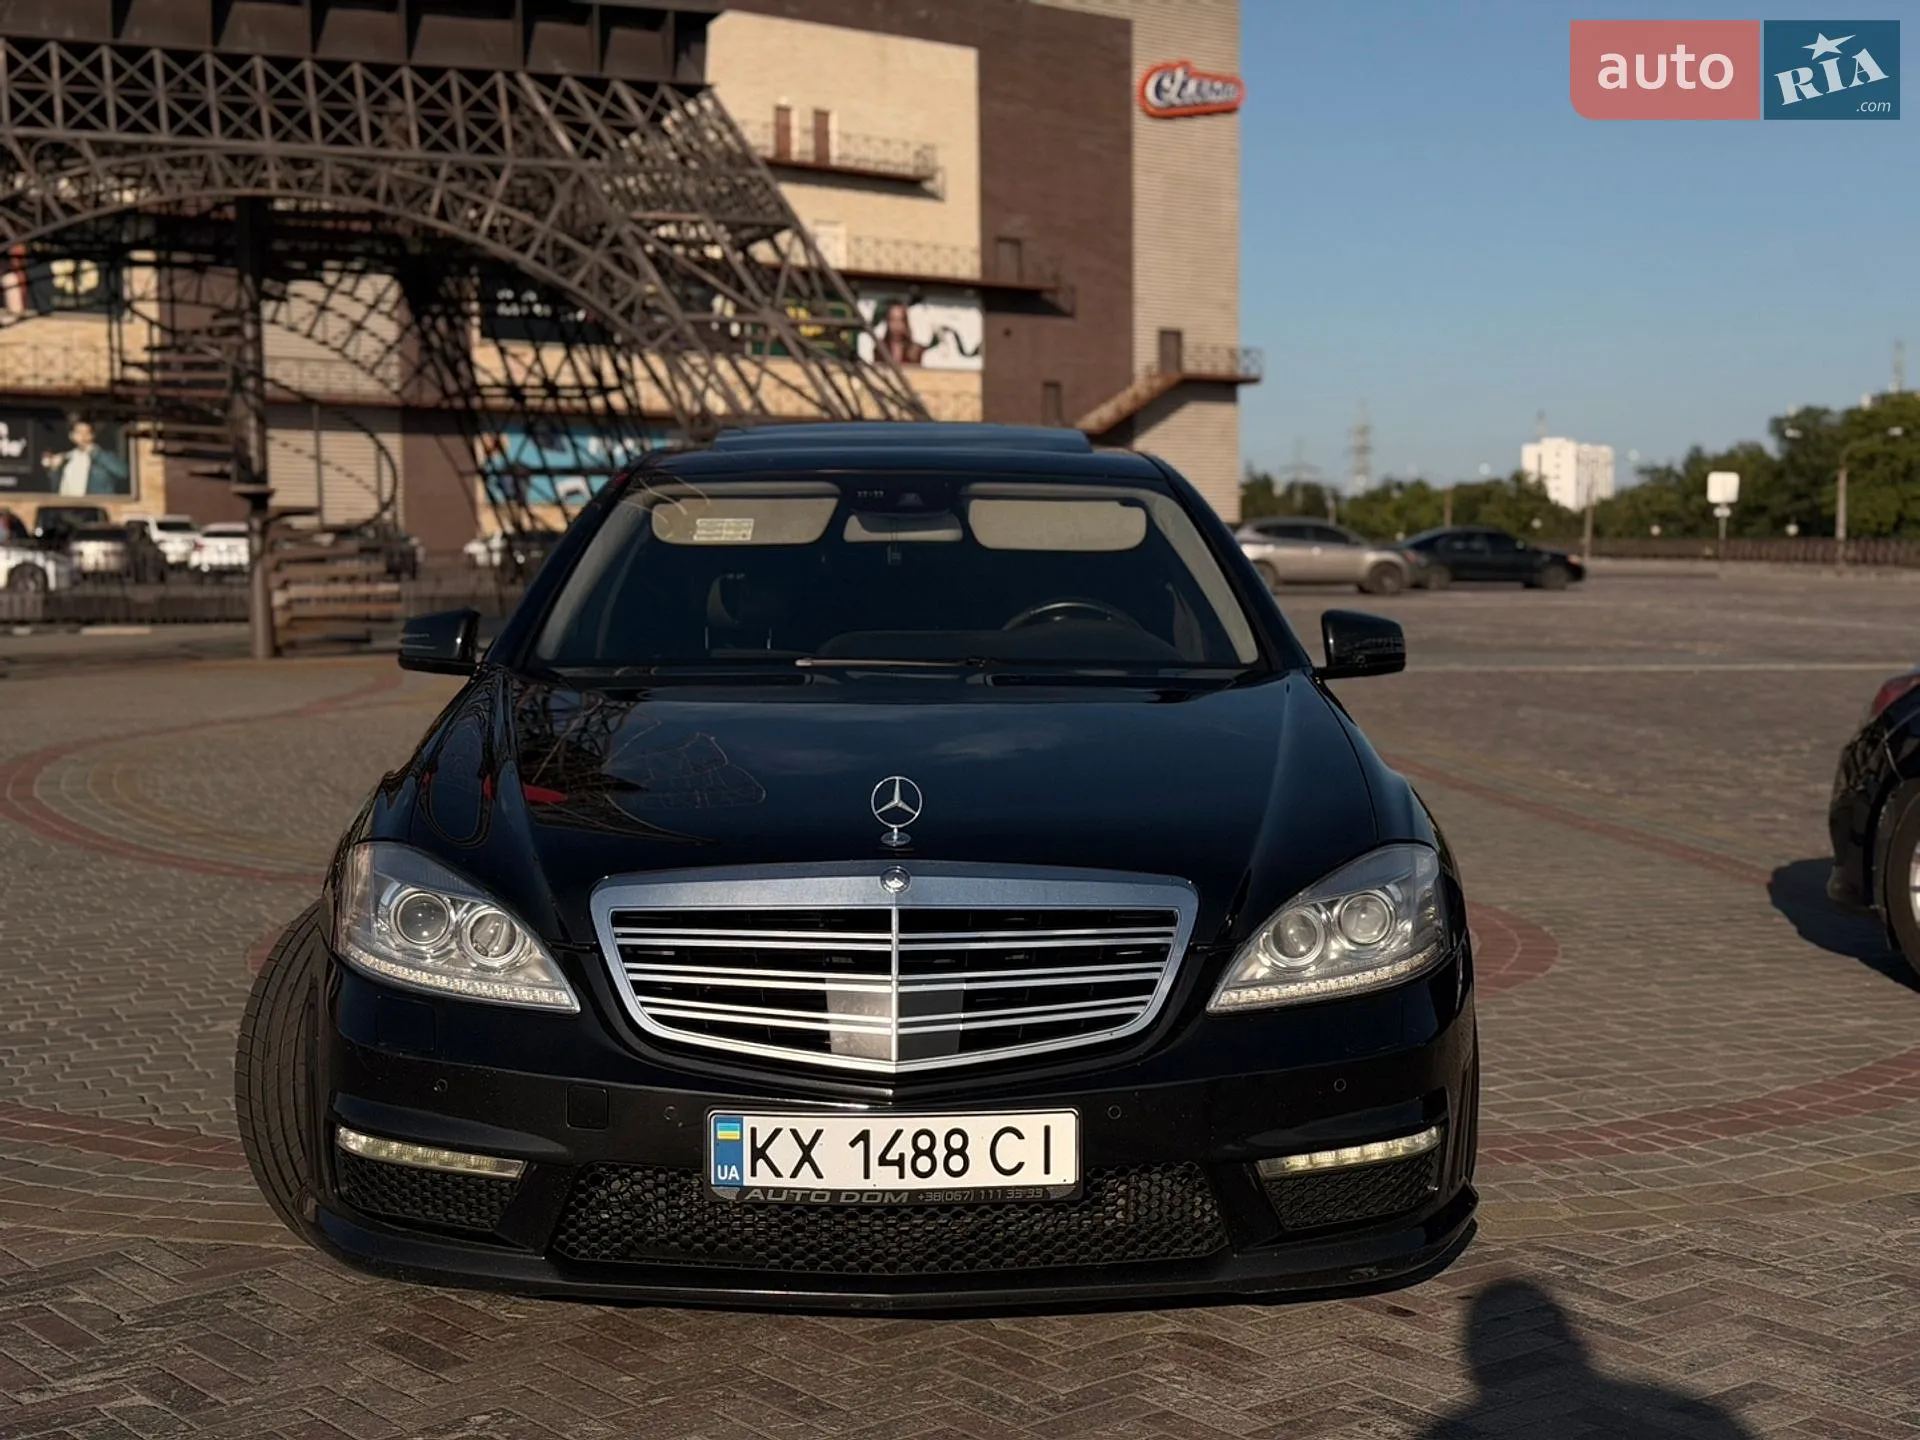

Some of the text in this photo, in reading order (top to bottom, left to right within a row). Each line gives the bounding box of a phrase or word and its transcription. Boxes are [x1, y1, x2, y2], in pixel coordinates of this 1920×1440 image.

[750, 1126, 824, 1179] KX
[848, 1127, 970, 1180] 1488
[717, 1164, 740, 1181] UA
[744, 1188, 831, 1202] AUTO
[839, 1191, 909, 1204] DOM
